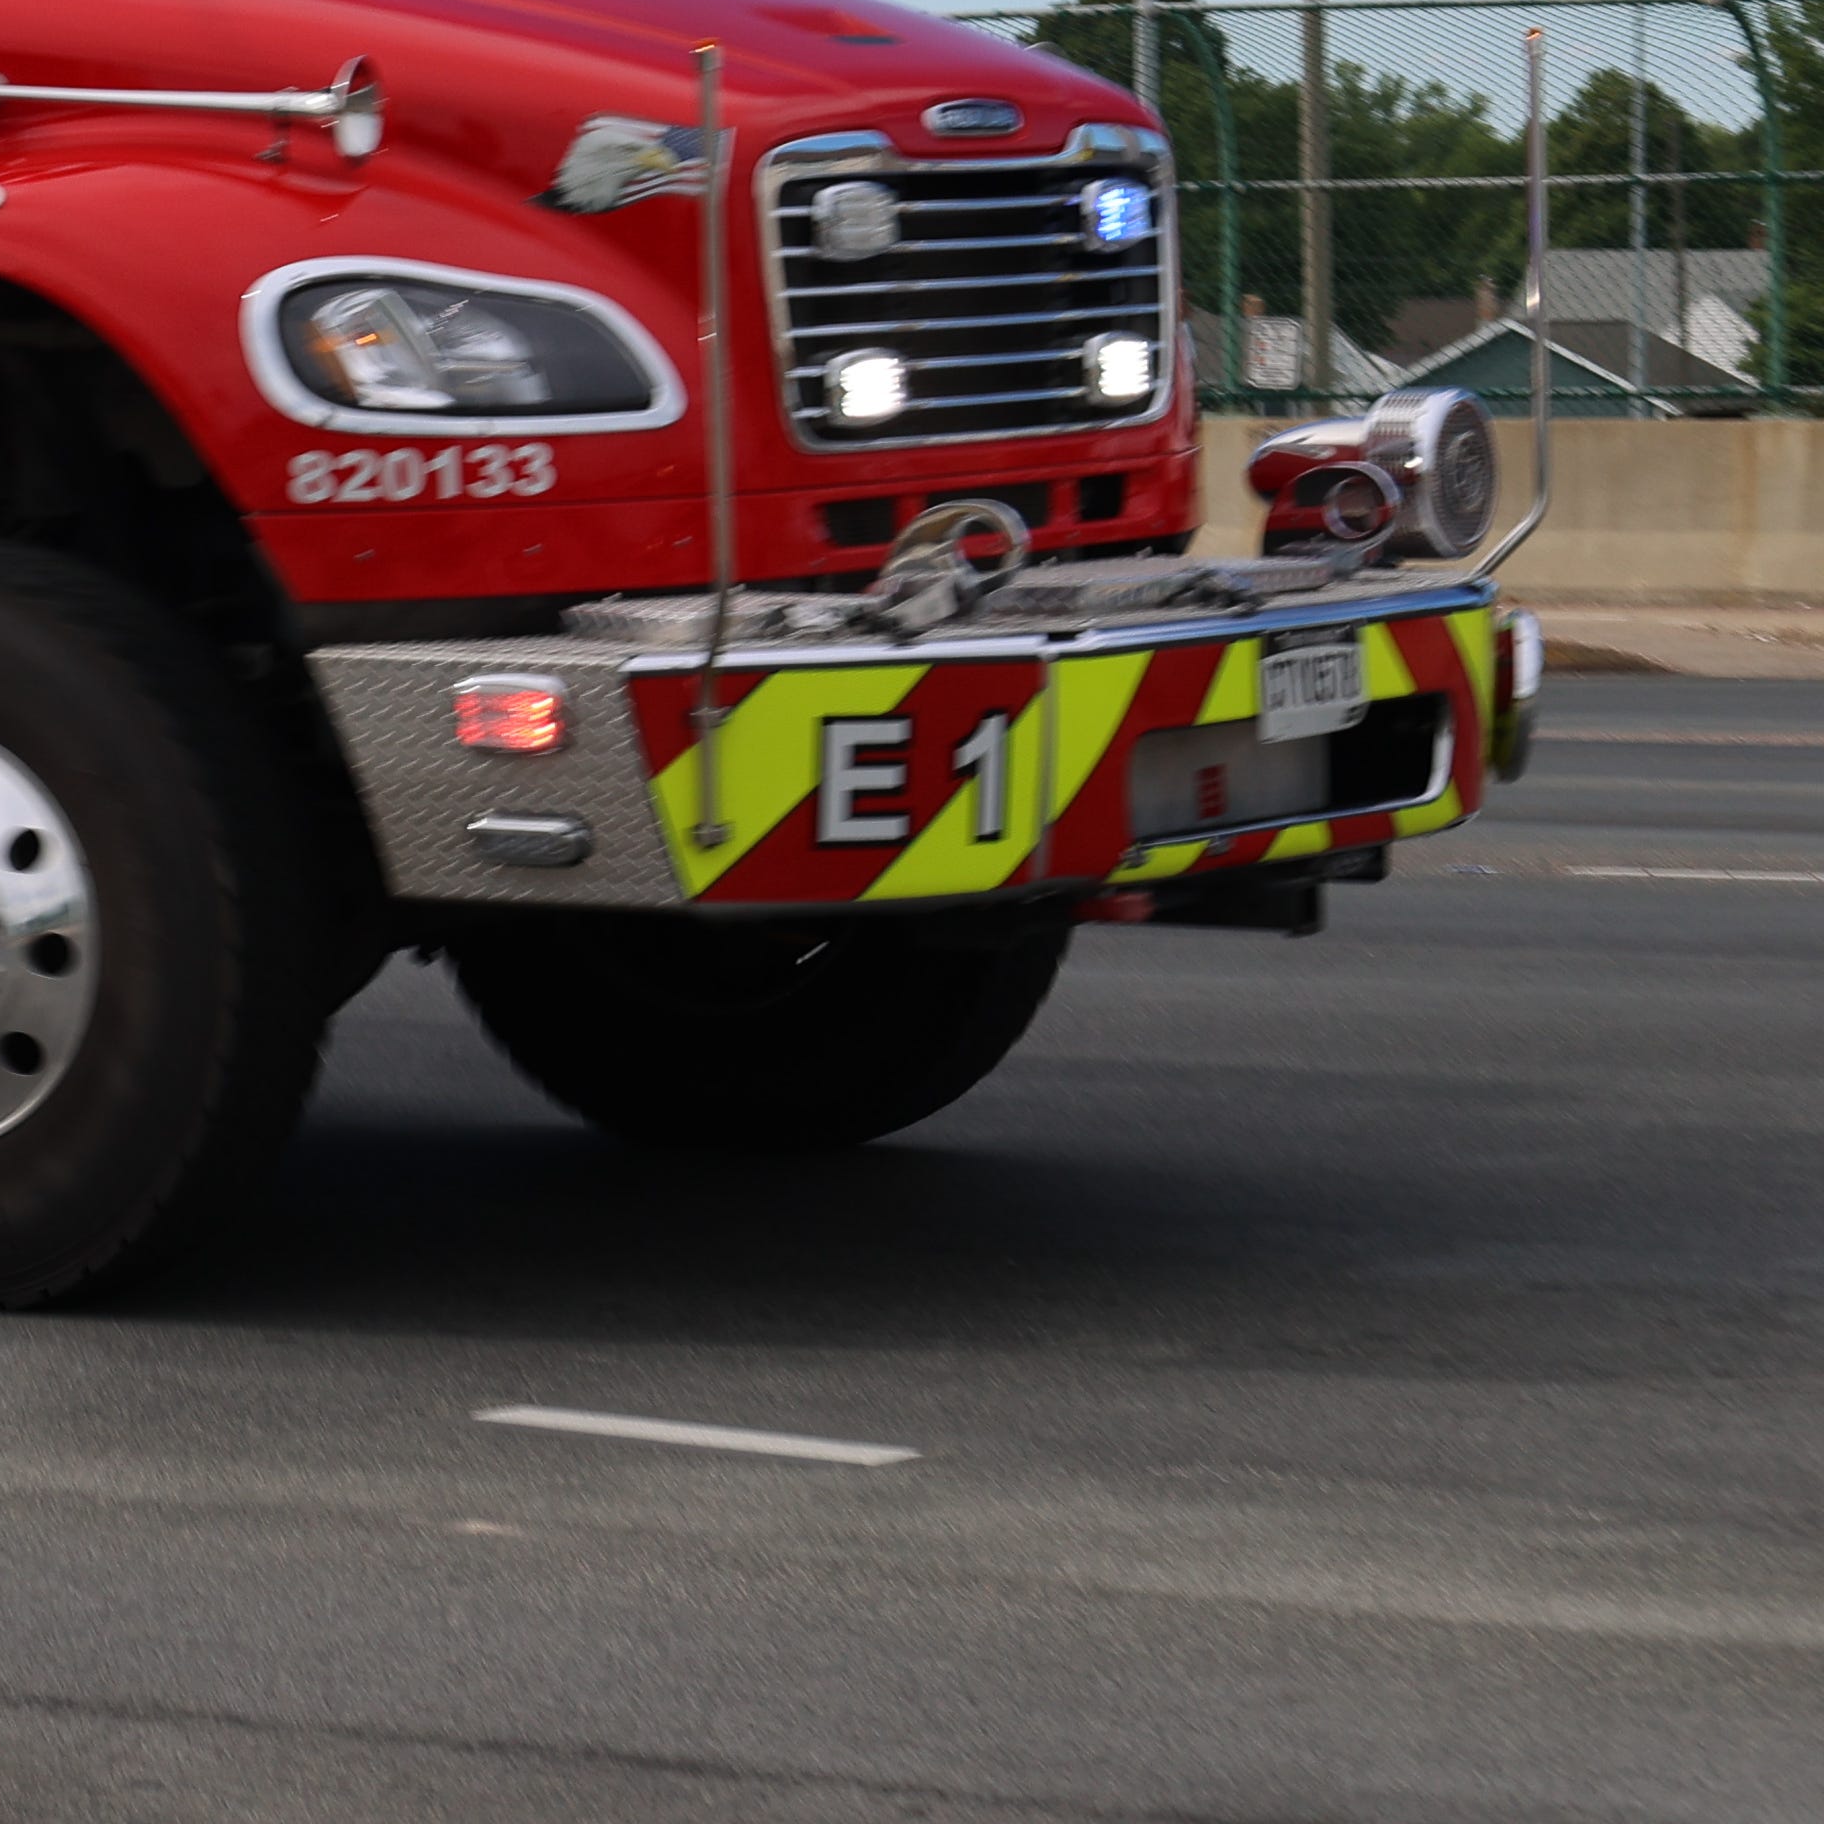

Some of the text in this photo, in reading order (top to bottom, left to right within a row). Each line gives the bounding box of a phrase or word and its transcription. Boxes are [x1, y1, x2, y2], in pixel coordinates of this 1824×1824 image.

[287, 440, 558, 505] 820133
[816, 709, 1010, 848] E 1
